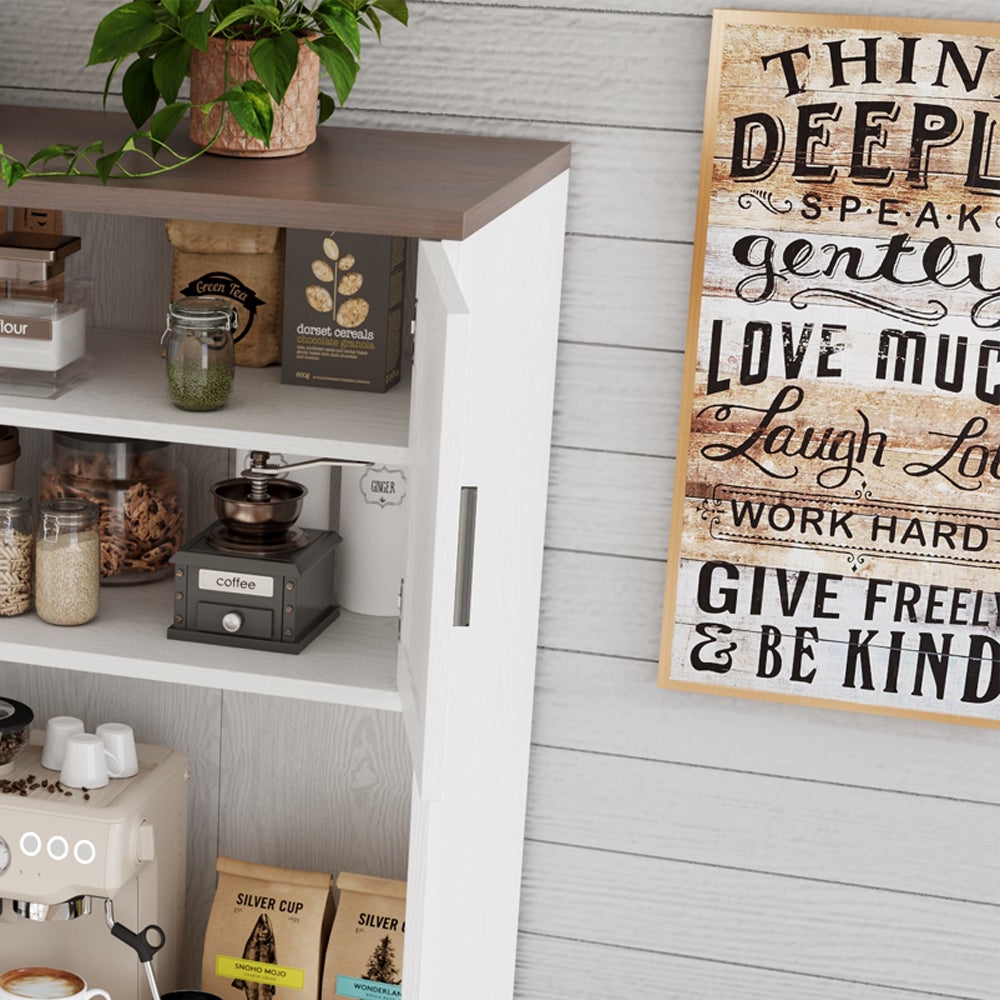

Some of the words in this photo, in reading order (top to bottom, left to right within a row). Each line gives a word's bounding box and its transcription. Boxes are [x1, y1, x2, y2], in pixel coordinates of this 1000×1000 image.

[761, 37, 1000, 99] THIN
[196, 280, 225, 294] Green
[229, 283, 248, 301] Tea
[296, 323, 332, 337] dorset
[334, 328, 374, 340] cereals
[296, 335, 339, 346] chocolate
[706, 319, 847, 395] LOVE
[697, 385, 887, 488] Laugh
[371, 480, 395, 493] GINGER
[730, 499, 854, 538] WORK
[871, 515, 988, 551] HARD
[216, 576, 256, 590] coffee
[697, 561, 843, 619] GIVE
[690, 622, 737, 674] &
[756, 625, 821, 684] BE
[842, 629, 1000, 704] KIND
[236, 892, 276, 911] SILVER
[279, 899, 304, 914] CUP
[358, 912, 399, 931] SILVER
[264, 968, 286, 978] MOJO
